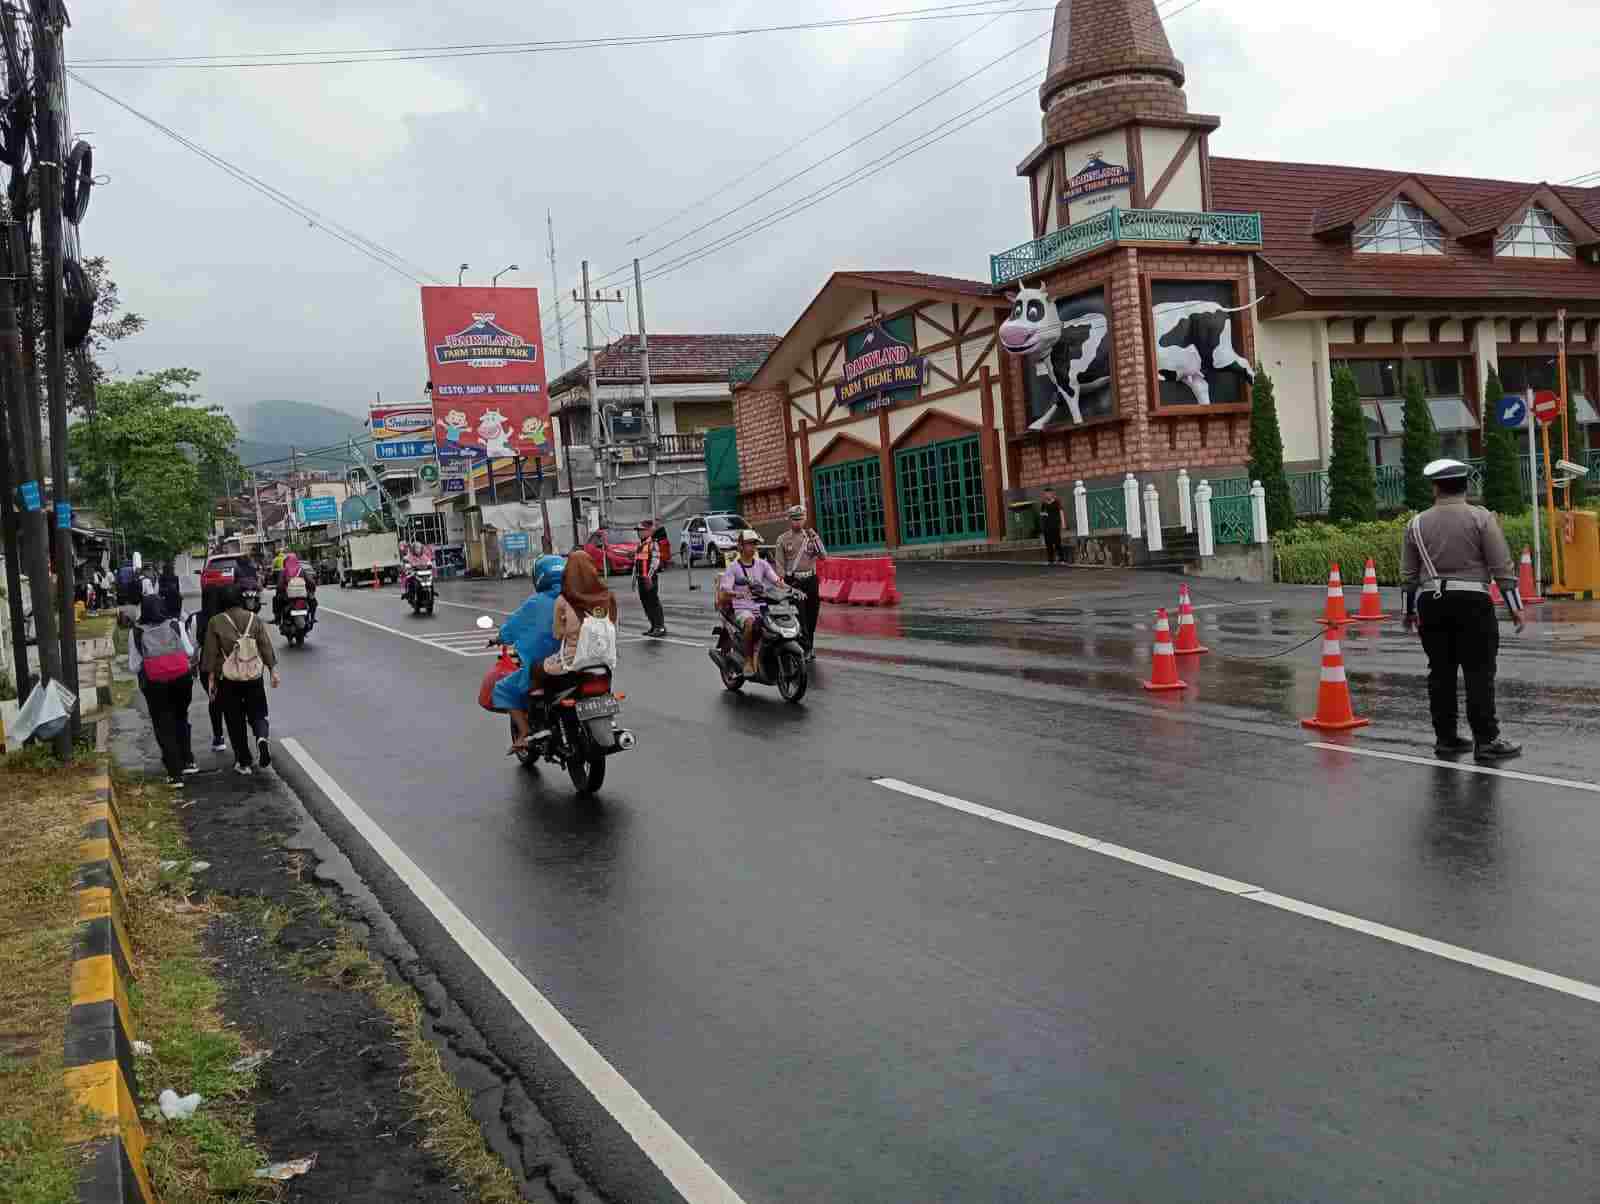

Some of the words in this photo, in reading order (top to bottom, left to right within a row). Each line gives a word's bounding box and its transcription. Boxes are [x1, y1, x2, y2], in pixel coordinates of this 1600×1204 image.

[444, 347, 468, 359] FARM
[472, 347, 504, 357] THEME
[506, 347, 528, 358] PARK
[846, 346, 910, 380] DAIRYLAND
[841, 380, 862, 400] FARM
[863, 369, 893, 390] THEME
[895, 365, 917, 381] PARK
